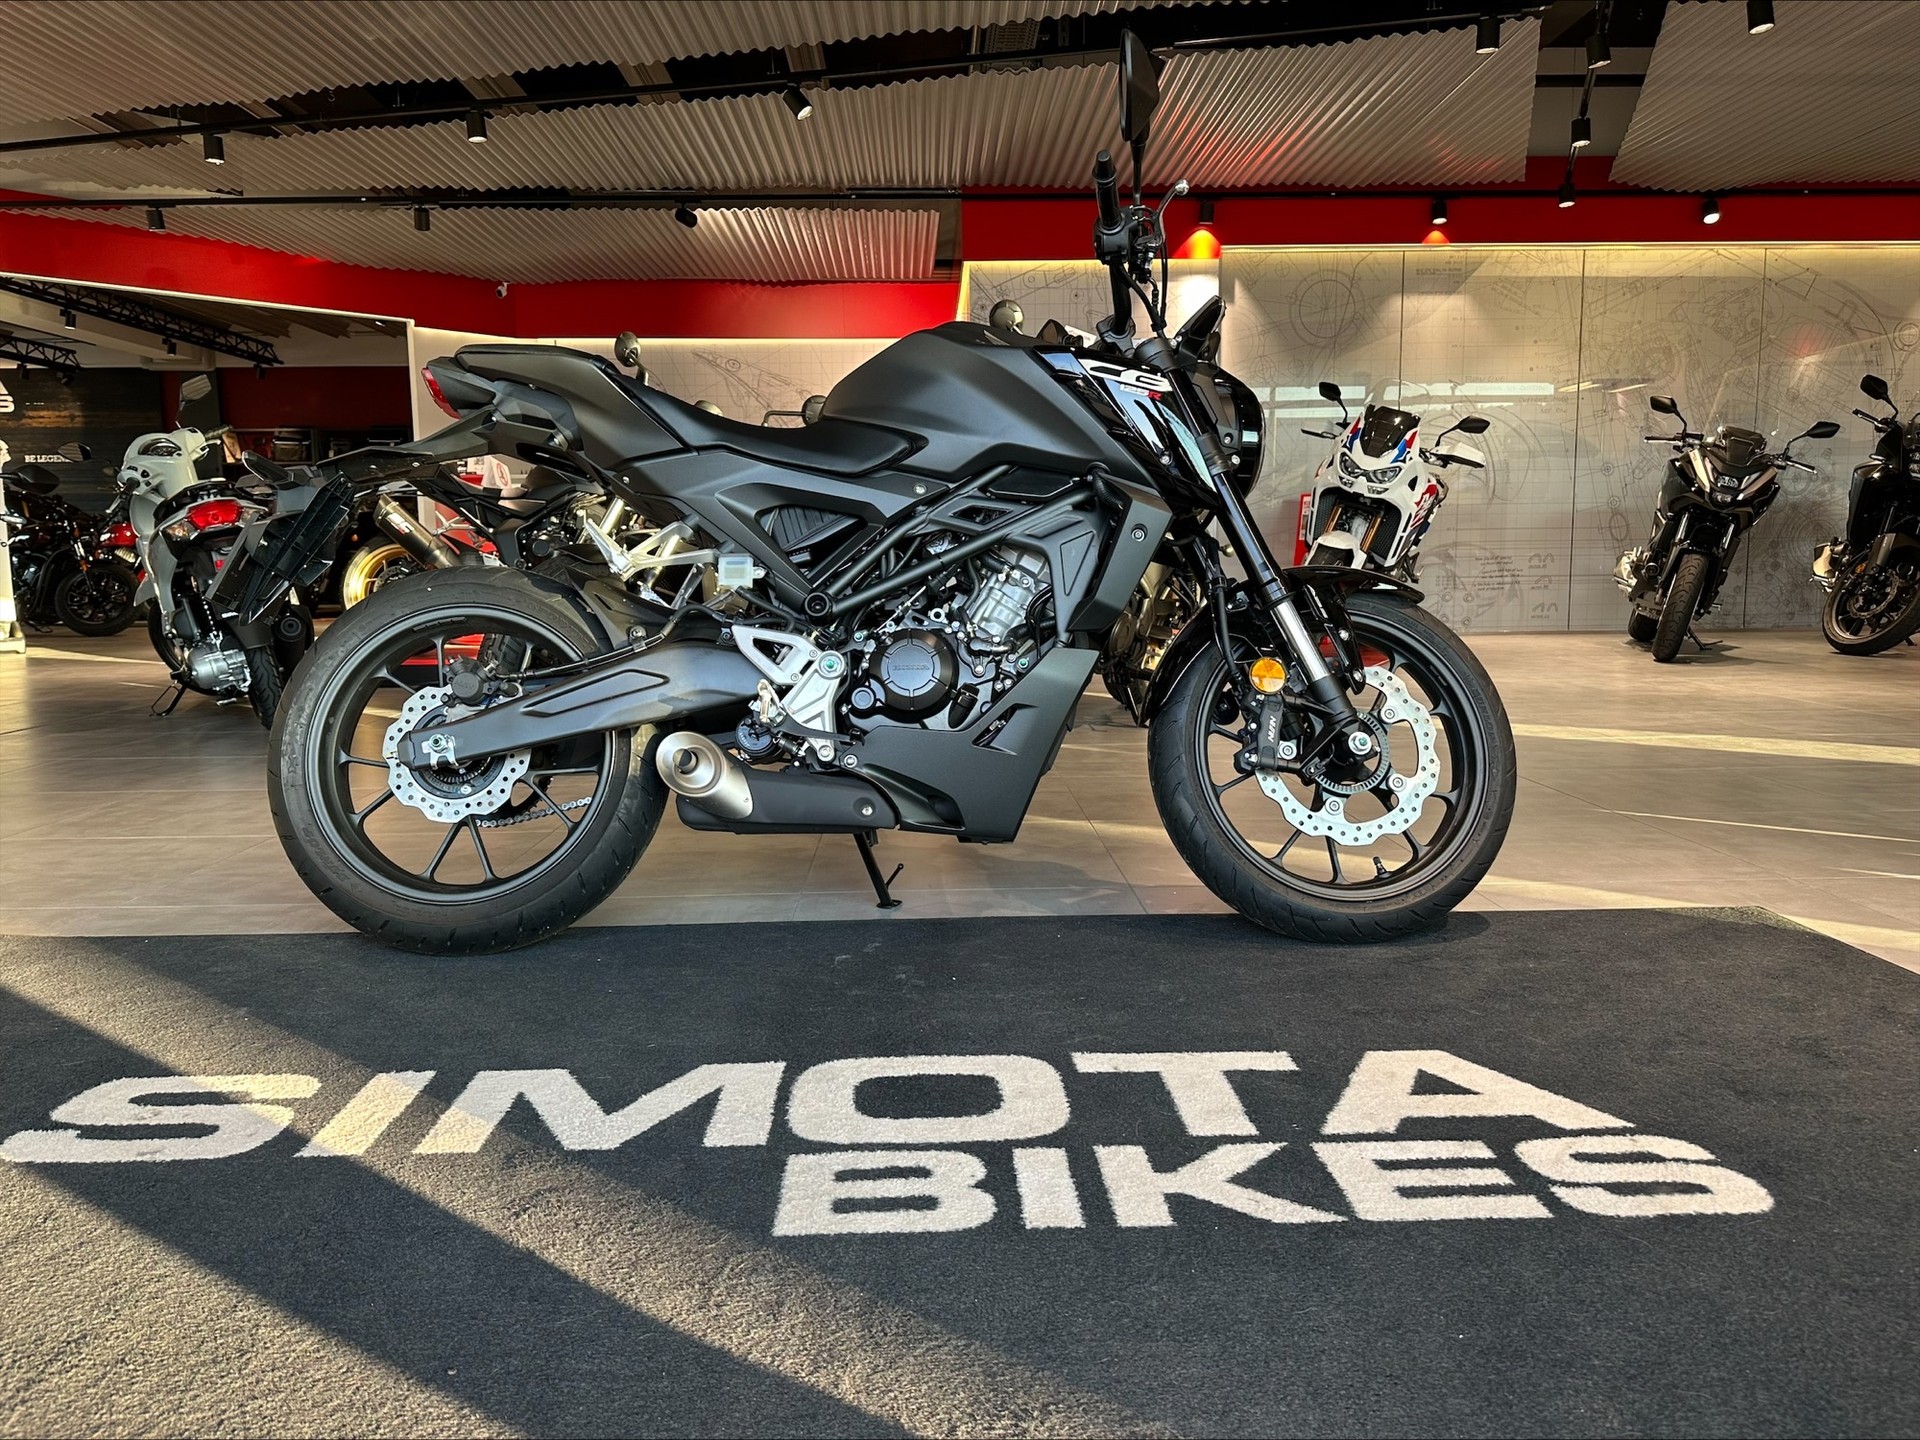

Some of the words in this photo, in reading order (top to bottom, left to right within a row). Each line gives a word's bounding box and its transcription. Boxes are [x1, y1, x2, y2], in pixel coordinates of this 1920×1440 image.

[1078, 359, 1173, 392] CB
[1120, 383, 1162, 401] 125R
[24, 454, 36, 463] BE
[37, 454, 73, 463] LEGEN
[0, 1049, 1632, 1164] SIMOTA
[772, 1134, 1776, 1237] BIKES
